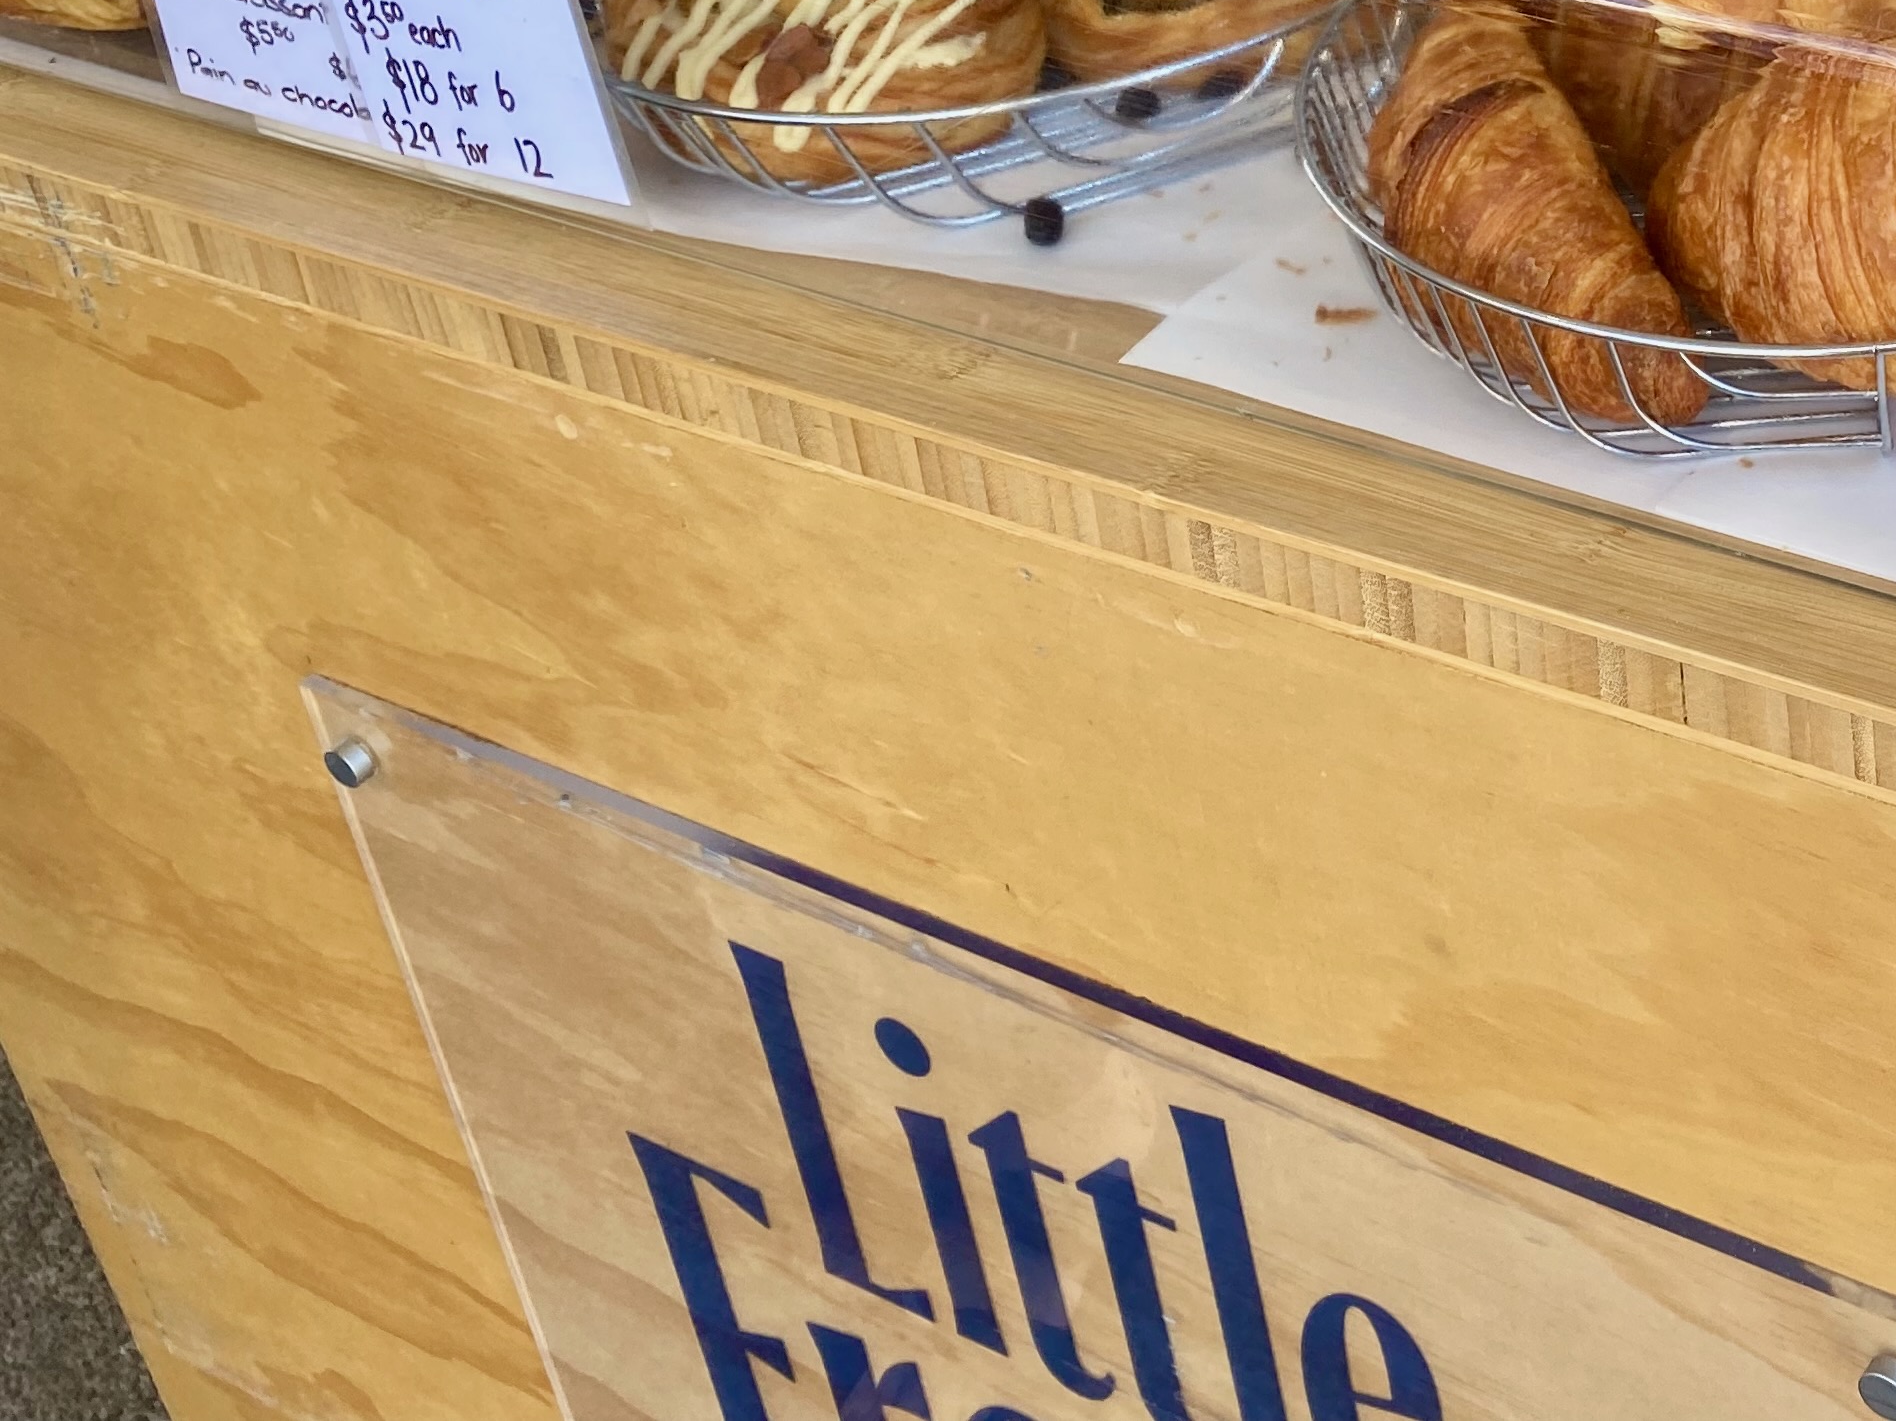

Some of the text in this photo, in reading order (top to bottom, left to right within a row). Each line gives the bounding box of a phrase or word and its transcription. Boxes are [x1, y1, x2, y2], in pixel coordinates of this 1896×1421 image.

[408, 15, 462, 52] each
[187, 48, 235, 85] Pain
[385, 47, 515, 114] $18 for 6
[382, 98, 554, 179] $29 for 12
